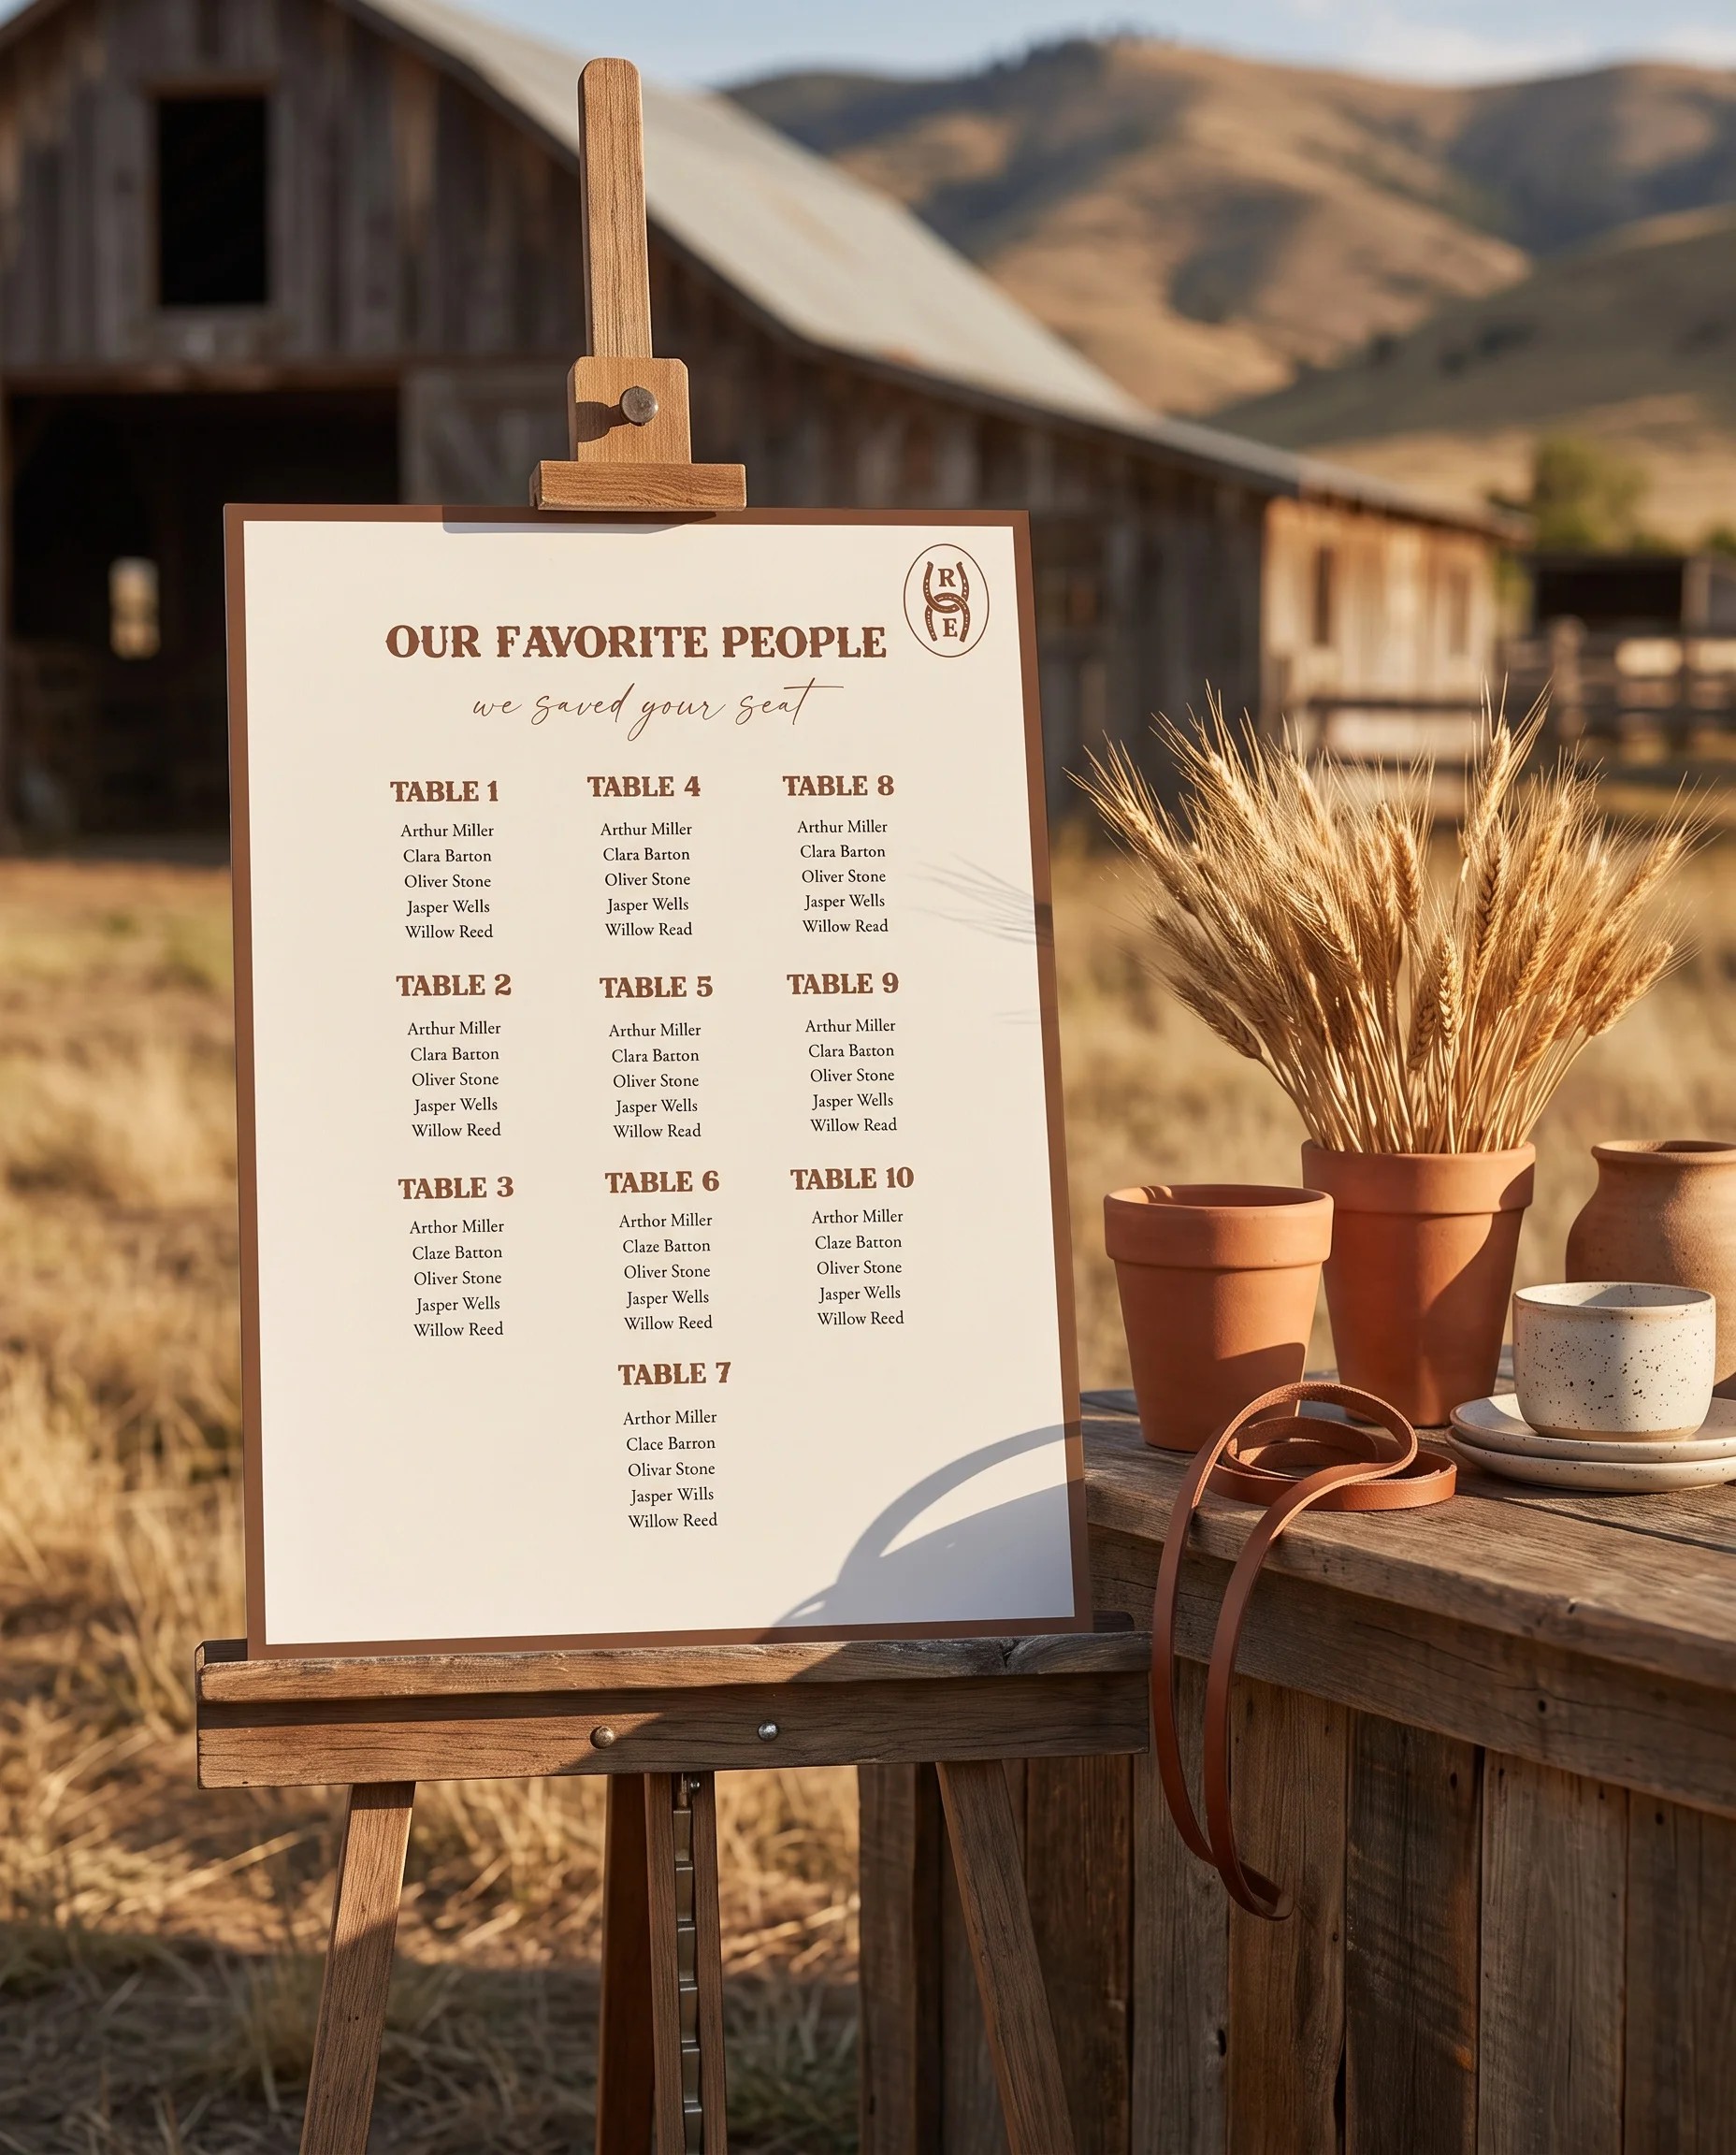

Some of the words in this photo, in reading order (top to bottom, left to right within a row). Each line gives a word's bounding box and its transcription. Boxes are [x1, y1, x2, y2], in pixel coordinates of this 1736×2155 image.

[938, 568, 956, 587] R
[942, 617, 958, 637] E
[384, 624, 482, 658] OUR
[496, 625, 709, 658] FAVORITE
[721, 625, 887, 659] PEOPLE
[472, 701, 523, 717] we
[530, 682, 635, 726] saved
[627, 701, 727, 742] your
[734, 676, 845, 726] seat
[389, 780, 480, 803] TABLE
[486, 779, 499, 803] 1
[586, 775, 675, 798] TABLE
[683, 775, 702, 798] 4
[781, 774, 869, 797] TABLE
[876, 774, 895, 797] 8
[399, 822, 449, 838] Arthur
[452, 822, 495, 837] Miller
[600, 821, 648, 836] Arthur
[651, 821, 693, 836] Miller
[796, 818, 844, 833] Arthur
[846, 818, 889, 833] Miller
[402, 848, 441, 863] Clara
[444, 848, 492, 862] Barton
[602, 846, 641, 861] Clara
[644, 846, 691, 861] Barton
[800, 844, 837, 859] Clara
[839, 844, 887, 858] Barton
[404, 874, 449, 889] Oliver
[452, 874, 492, 889] Stone
[604, 872, 648, 887] Oliver
[651, 872, 691, 887] Stone
[801, 869, 845, 884] Oliver
[847, 868, 887, 883] Stone
[405, 900, 449, 918] Jasper
[452, 898, 490, 914] Wells
[605, 898, 649, 916] Jasper
[651, 896, 689, 911] Wells
[803, 894, 846, 912] Jasper
[848, 892, 886, 907] Wells
[404, 924, 456, 939] Willow
[458, 923, 494, 939] Reed
[604, 921, 655, 936] Willow
[658, 920, 693, 936] Read
[802, 918, 851, 933] Willow
[854, 918, 890, 933] Read
[395, 974, 486, 997] TABLE
[494, 973, 512, 996] 2
[599, 976, 687, 999] TABLE
[696, 975, 714, 998] 5
[786, 973, 874, 995] TABLE
[881, 972, 900, 994] 9
[407, 1020, 456, 1036] Arthur
[458, 1020, 501, 1035] Miller
[608, 1022, 657, 1037] Arthur
[659, 1021, 702, 1037] Miller
[804, 1018, 852, 1034] Arthur
[855, 1018, 896, 1033] Miller
[410, 1046, 448, 1062] Clara
[611, 1048, 649, 1063] Clara
[808, 1043, 846, 1059] Clara
[412, 1072, 456, 1087] Oliver
[459, 1071, 499, 1086] Stone
[613, 1073, 657, 1089] Oliver
[659, 1073, 700, 1088] Stone
[810, 1067, 853, 1083] Oliver
[856, 1067, 895, 1082] Stone
[412, 1098, 456, 1116] Jasper
[458, 1095, 499, 1111] Wells
[614, 1099, 658, 1118] Jasper
[660, 1097, 699, 1113] Wells
[811, 1093, 854, 1112] Jasper
[856, 1092, 894, 1107] Wells
[411, 1122, 463, 1137] Willow
[466, 1121, 502, 1137] Reed
[613, 1123, 664, 1138] Willow
[667, 1121, 702, 1138] Read
[809, 1118, 861, 1133] Willow
[863, 1116, 898, 1132] Read
[604, 1170, 694, 1194] TABLE
[702, 1169, 720, 1193] 6
[789, 1167, 877, 1191] TABLE
[885, 1166, 915, 1189] 10
[398, 1177, 487, 1200] TABLE
[496, 1176, 514, 1198] 3
[618, 1212, 668, 1228] Arthor
[670, 1211, 713, 1227] Miller
[811, 1208, 860, 1224] Arthor
[861, 1208, 904, 1223] Miller
[409, 1219, 458, 1235] Arthor
[461, 1218, 505, 1234] Miller
[623, 1264, 668, 1280] Oliver
[671, 1264, 711, 1279] Stone
[817, 1260, 861, 1276] Oliver
[862, 1259, 903, 1275] Stone
[413, 1270, 458, 1286] Oliver
[462, 1270, 502, 1285] Stone
[625, 1291, 669, 1309] Jasper
[671, 1288, 710, 1304] Wells
[817, 1286, 861, 1305] Jasper
[862, 1284, 902, 1299] Wells
[414, 1297, 459, 1316] Jasper
[461, 1294, 500, 1310] Wells
[623, 1315, 674, 1331] Willow
[678, 1313, 714, 1330] Reed
[817, 1310, 867, 1326] Willow
[870, 1309, 905, 1325] Reed
[412, 1322, 465, 1338] Willow
[468, 1320, 504, 1337] Reed
[617, 1362, 707, 1386] TABLE
[715, 1361, 731, 1384] 7
[622, 1410, 672, 1425] Arthor
[674, 1409, 717, 1425] Miller
[628, 1462, 673, 1478] Olivar
[675, 1461, 716, 1476] Stone
[629, 1489, 673, 1508] Jasper
[676, 1485, 715, 1501] Wills
[627, 1513, 679, 1528] Willow
[682, 1511, 718, 1527] Reed
